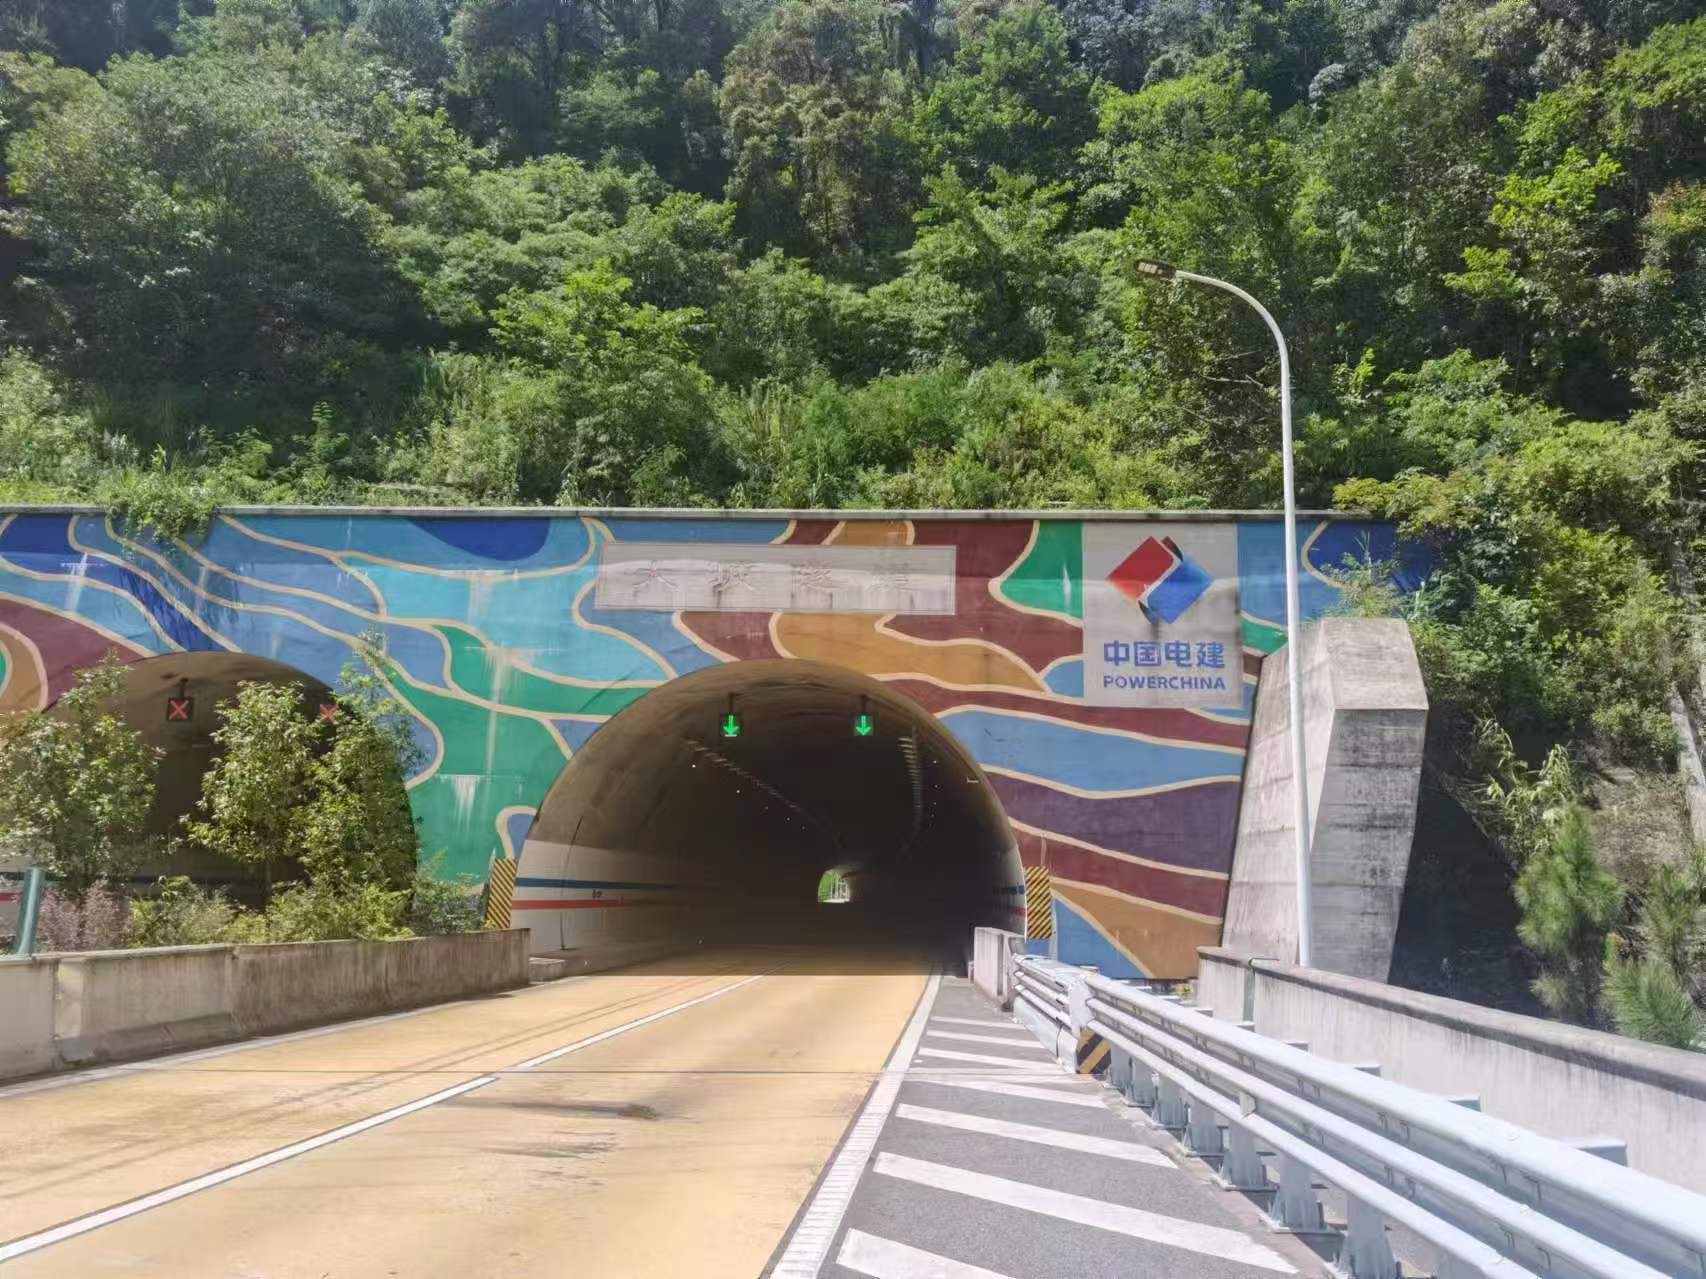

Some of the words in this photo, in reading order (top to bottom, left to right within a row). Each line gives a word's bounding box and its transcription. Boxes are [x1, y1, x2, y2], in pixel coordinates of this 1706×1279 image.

[1103, 640, 1226, 669] 中国电建
[1103, 675, 1226, 690] POWERCHINA
